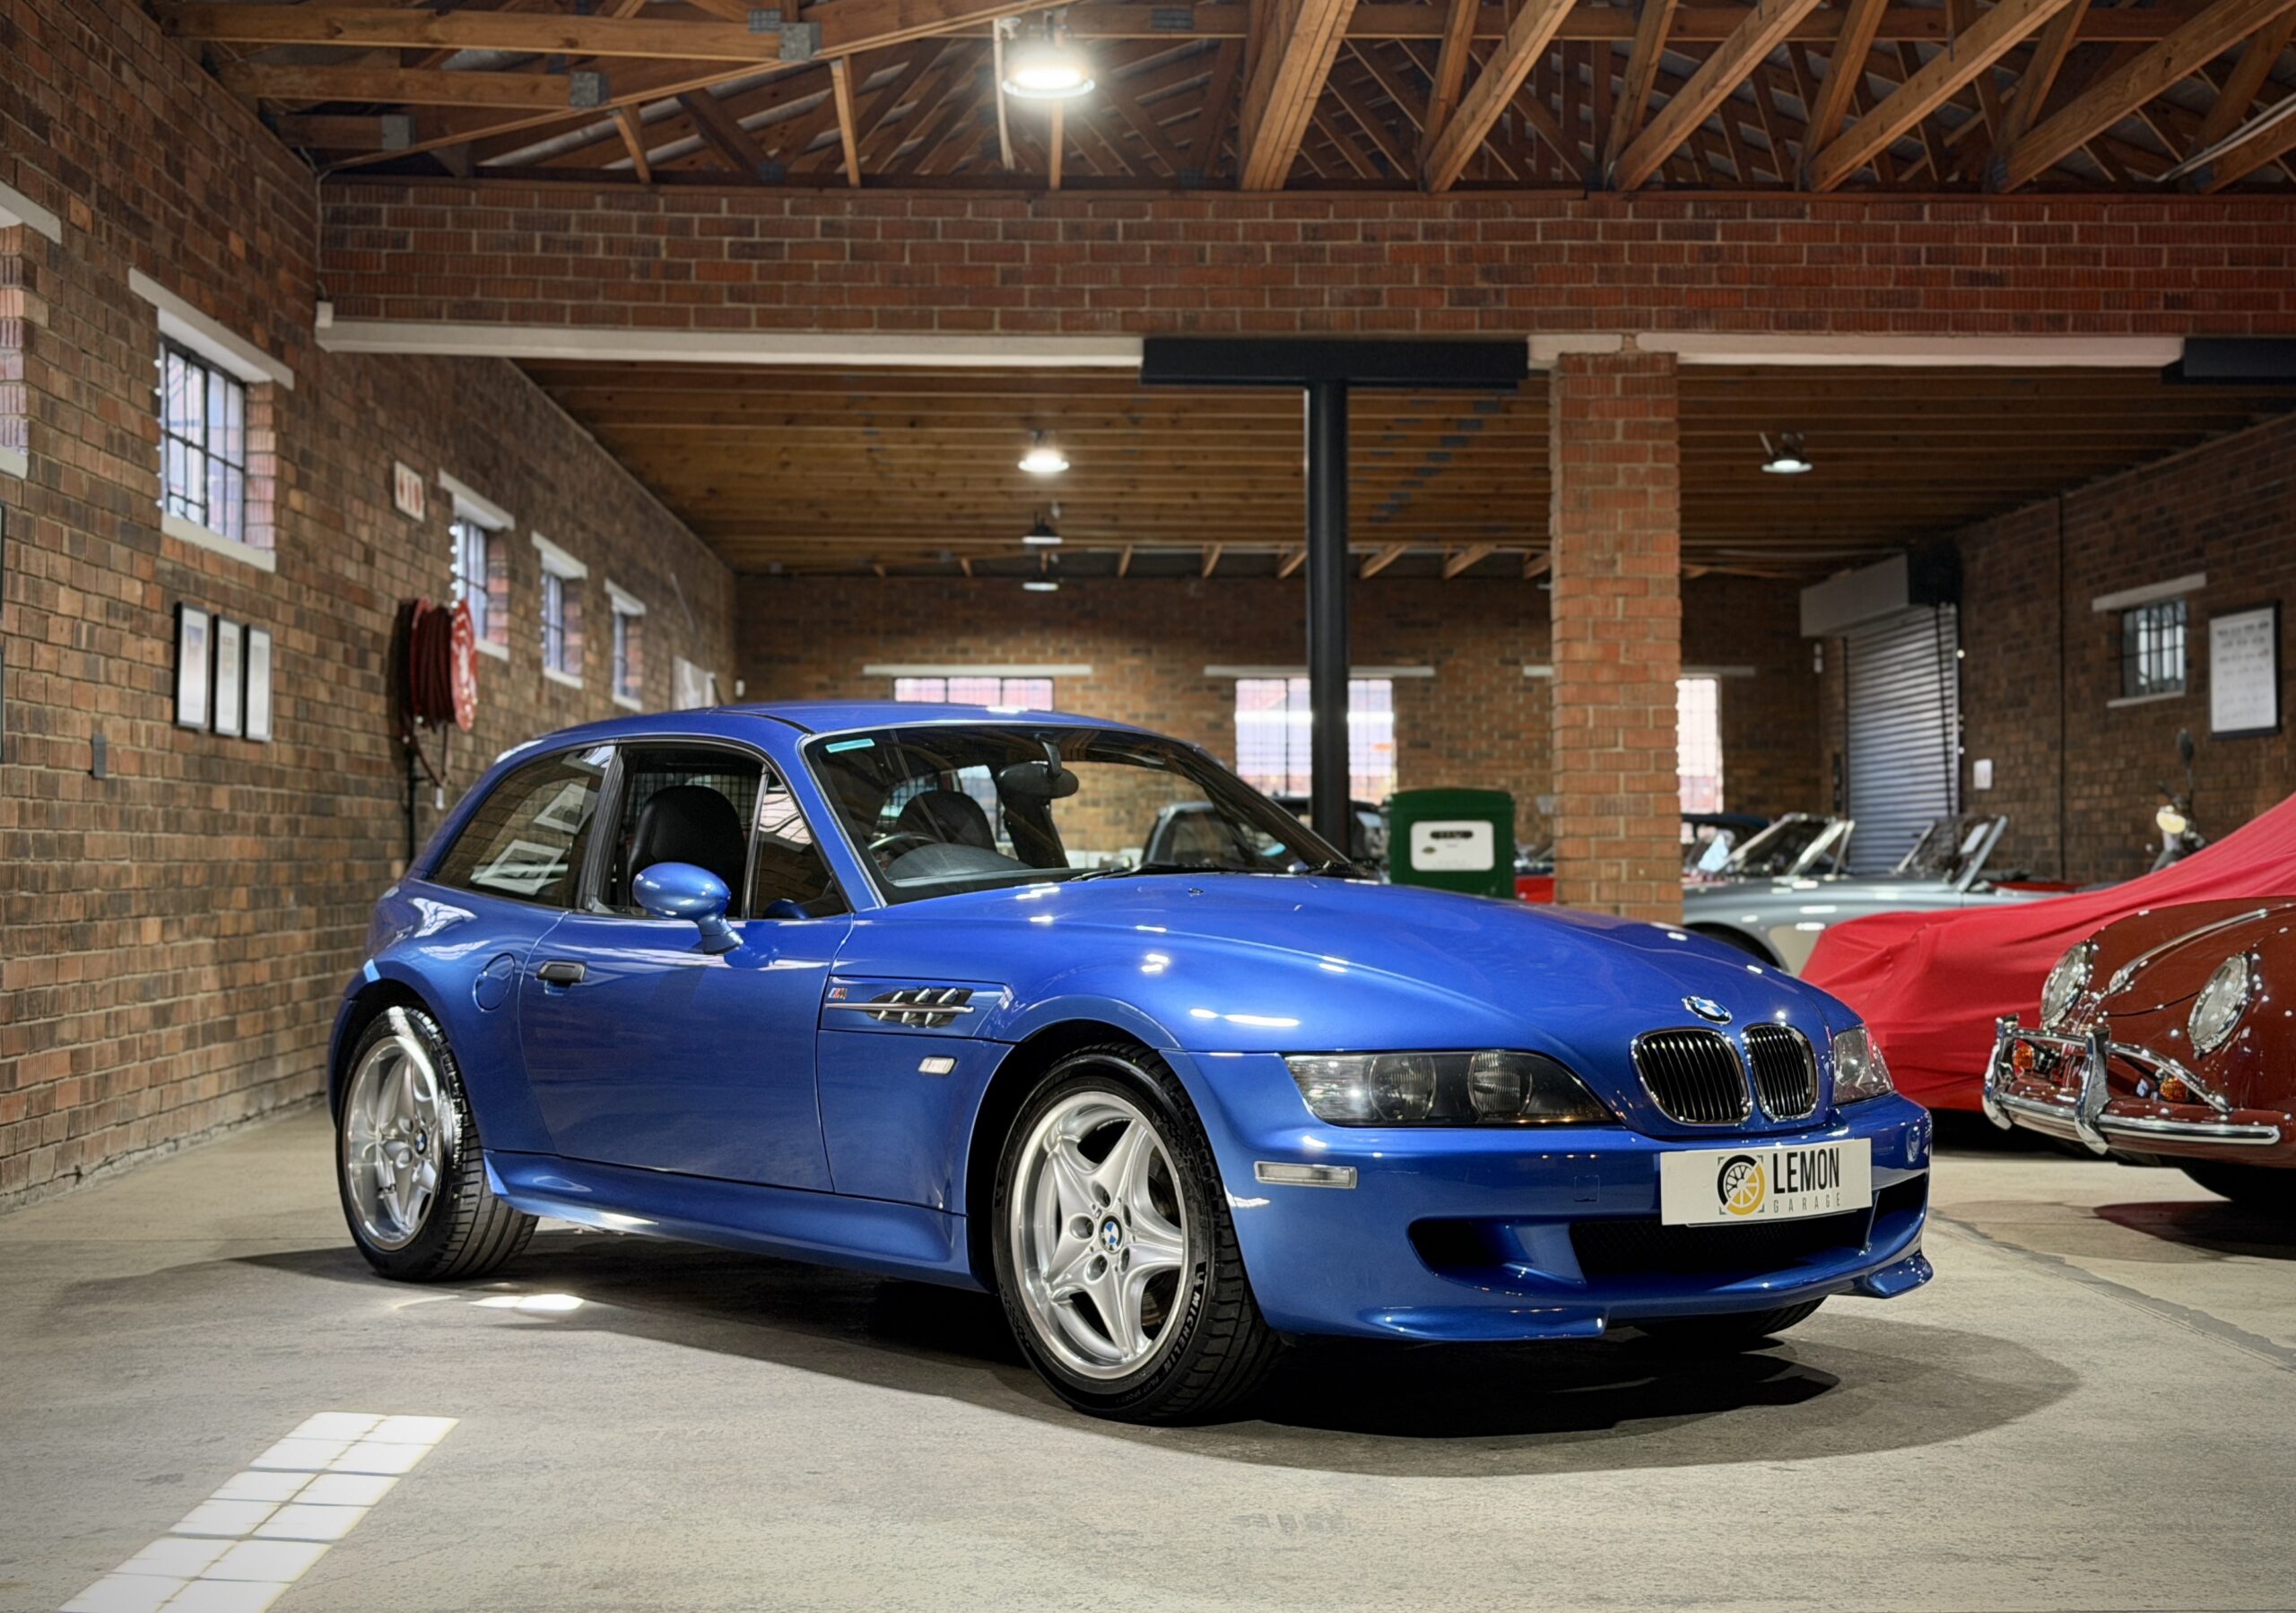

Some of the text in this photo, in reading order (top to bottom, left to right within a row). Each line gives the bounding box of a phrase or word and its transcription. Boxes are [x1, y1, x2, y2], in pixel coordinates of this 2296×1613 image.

[1773, 1148, 1839, 1193] LEMON
[1773, 1193, 1840, 1213] GARAGE
[1163, 1292, 1201, 1374] MICHELIN
